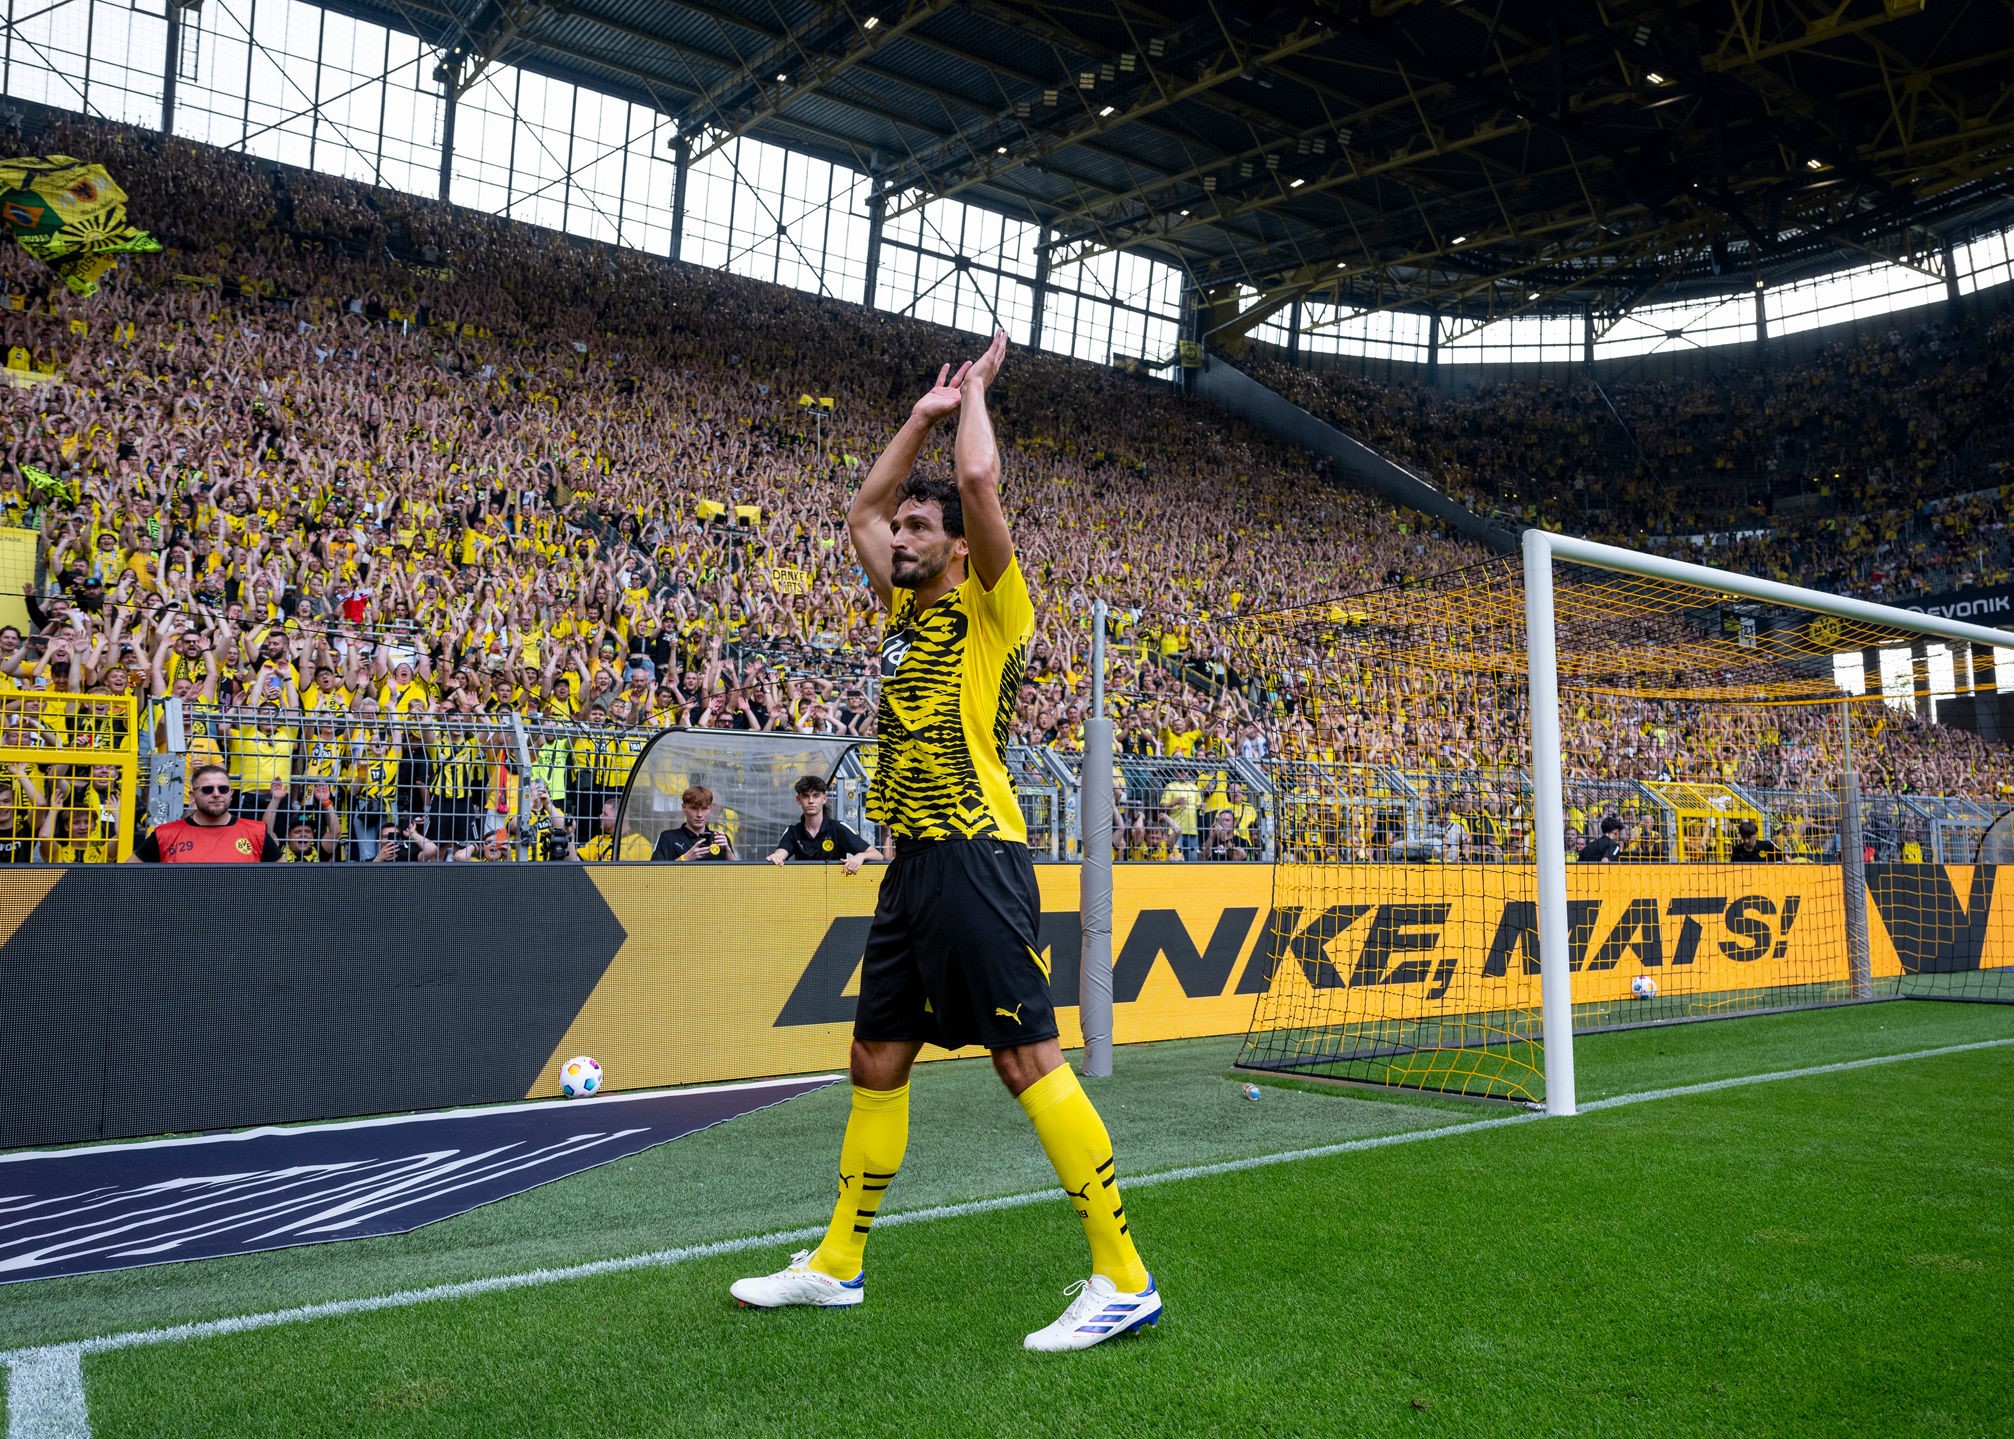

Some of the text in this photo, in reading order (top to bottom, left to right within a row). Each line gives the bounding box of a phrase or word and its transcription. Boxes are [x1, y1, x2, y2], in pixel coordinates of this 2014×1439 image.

[773, 569, 804, 580] DANKE
[1927, 596, 2011, 618] EVONIK
[168, 841, 194, 855] 6/29
[773, 895, 1801, 1026] NKE, MATS!
